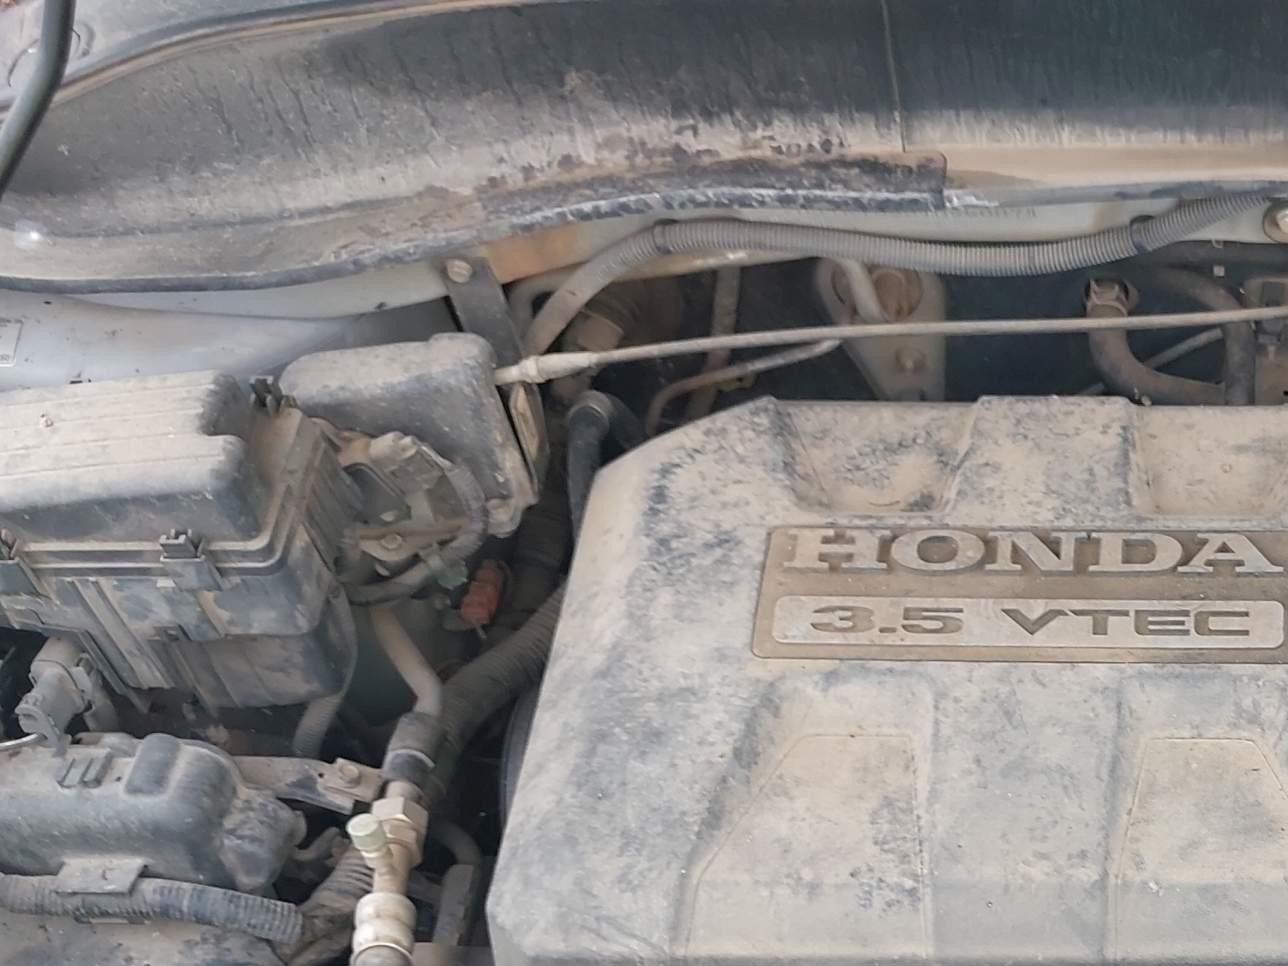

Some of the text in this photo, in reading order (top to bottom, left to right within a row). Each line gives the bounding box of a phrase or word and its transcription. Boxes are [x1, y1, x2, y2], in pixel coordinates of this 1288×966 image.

[783, 529, 1285, 575] HONDA
[810, 606, 1251, 638] 3.5 VTEC
